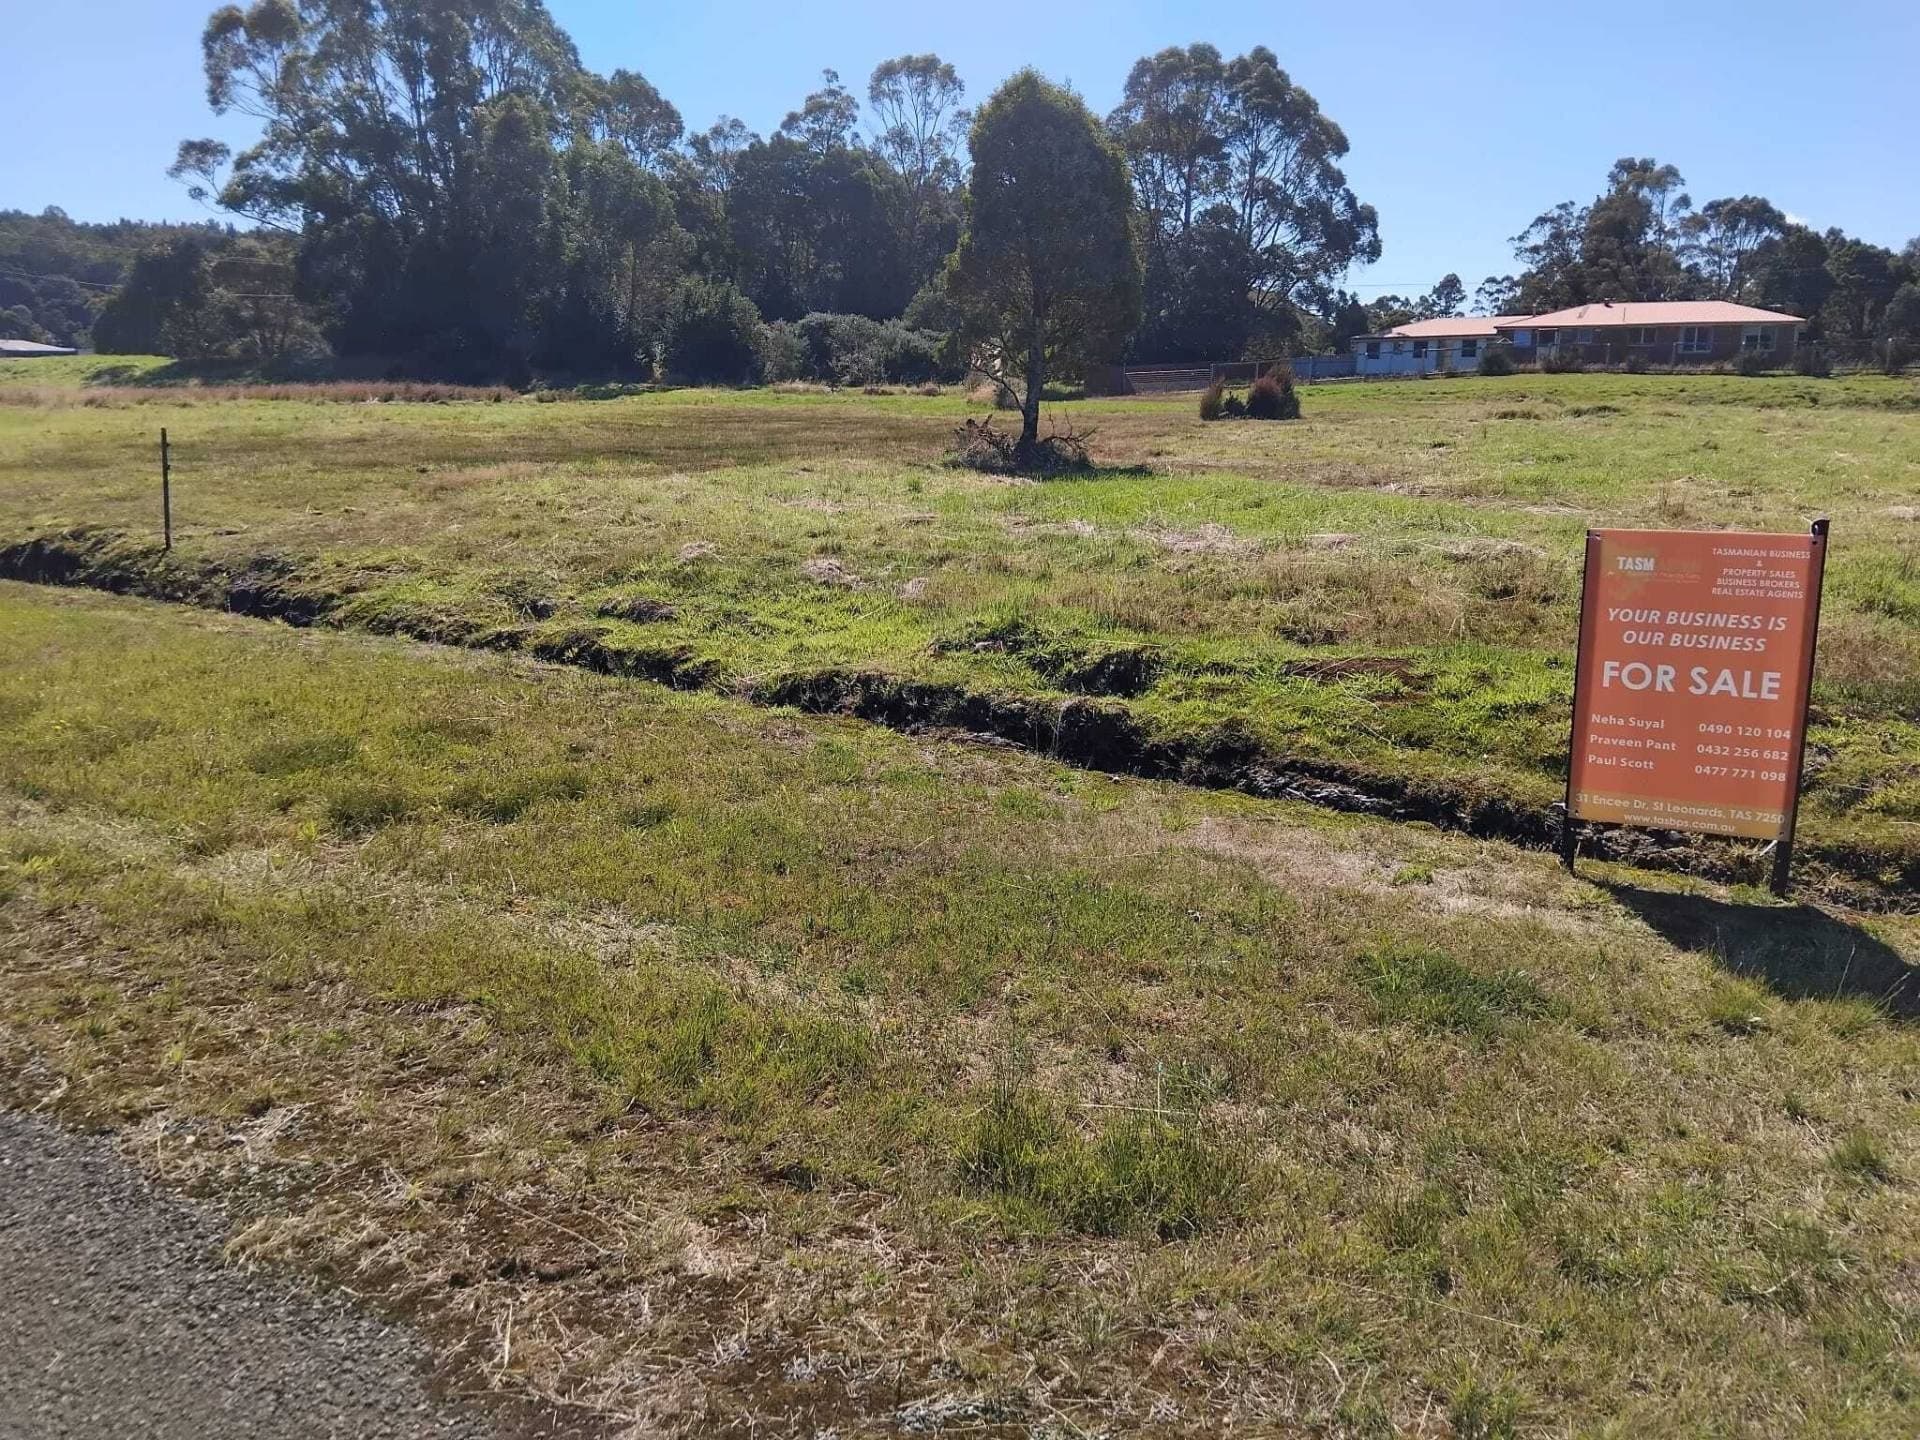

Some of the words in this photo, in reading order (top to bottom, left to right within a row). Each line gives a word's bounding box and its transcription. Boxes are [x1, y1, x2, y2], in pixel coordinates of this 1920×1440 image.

[1713, 548, 1767, 558] TASMANIAN
[1769, 550, 1811, 559] BUSINESS
[1723, 568, 1767, 578] PROPERTY
[1769, 570, 1796, 578] SALES
[1717, 578, 1757, 586] BUSINESS
[1760, 579, 1800, 588] BROKERS
[1712, 587, 1733, 595] REAL
[1736, 588, 1764, 597] ESTATE
[1767, 590, 1803, 599] AGENTS
[1608, 608, 1661, 624] YOUR
[1666, 611, 1761, 630] BUSINESS
[1768, 616, 1788, 631] IS
[1623, 630, 1664, 645] OUR
[1670, 633, 1767, 652] BUSINESS
[1602, 661, 1676, 692] FOR
[1688, 666, 1781, 700] SALE
[1592, 714, 1625, 726] Neha
[1627, 717, 1664, 731] Suyal
[1698, 723, 1732, 734] 0490
[1737, 726, 1761, 737] 120
[1766, 728, 1792, 740] 104
[1590, 734, 1642, 748] Praveen
[1646, 739, 1677, 751] Pant
[1697, 744, 1729, 756] 0432
[1734, 747, 1759, 758] 256
[1763, 750, 1789, 761] 682
[1588, 755, 1616, 766] Paul
[1620, 757, 1655, 770] Scott
[1695, 765, 1728, 776] 0477
[1732, 768, 1755, 779] 771
[1760, 770, 1786, 782] 098
[1593, 795, 1630, 807] Encee
[1652, 801, 1664, 810] St
[1729, 810, 1752, 820] TAS
[1754, 812, 1785, 824] 7250
[1624, 814, 1735, 832] www.tasbps.com.au
